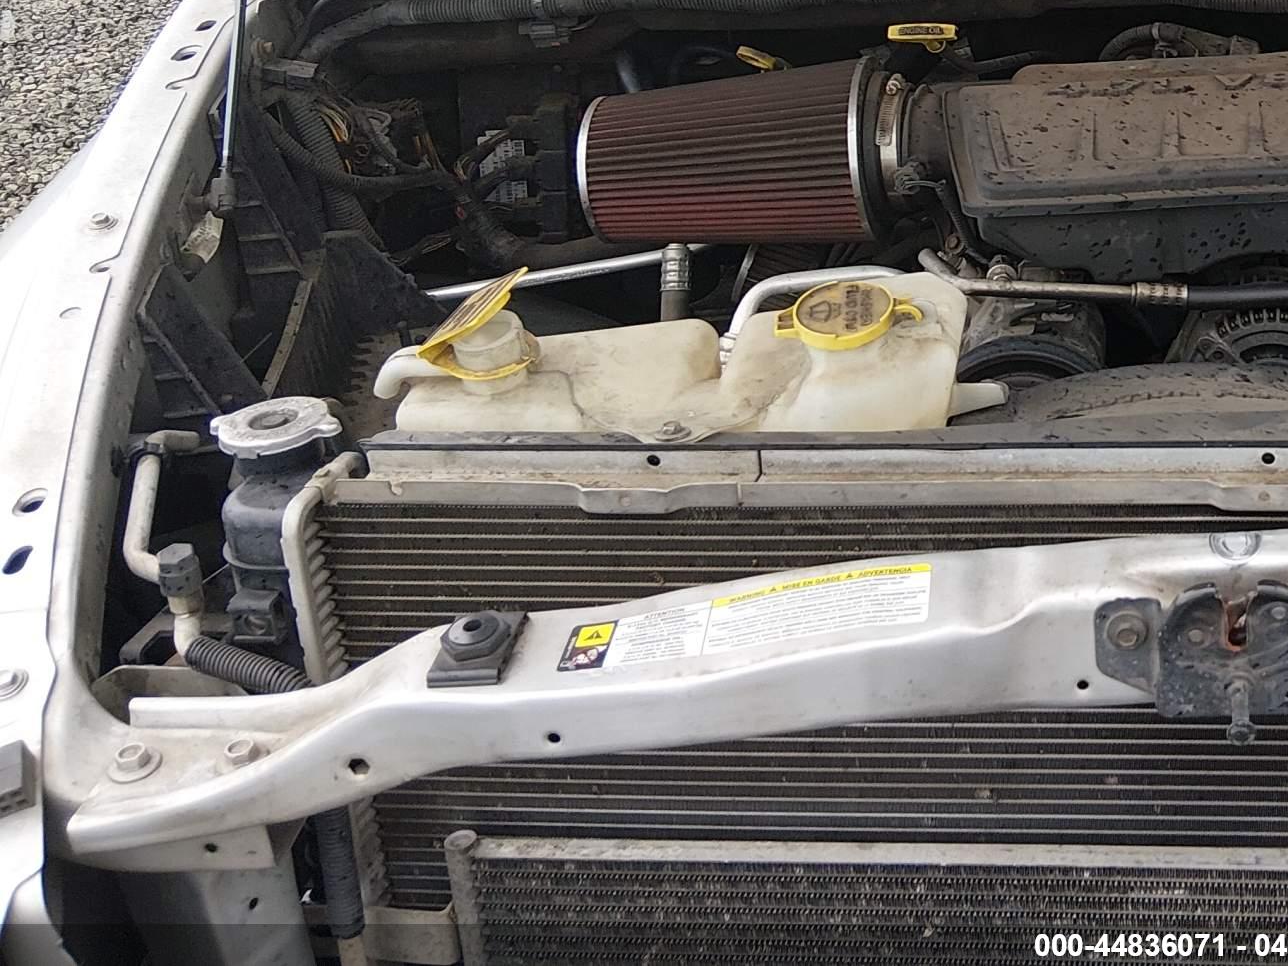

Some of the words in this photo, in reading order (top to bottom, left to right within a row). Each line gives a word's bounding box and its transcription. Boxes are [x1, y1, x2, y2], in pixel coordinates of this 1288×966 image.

[899, 26, 927, 35] ENGINE
[928, 26, 943, 35] OIL
[858, 567, 912, 578] ADVERTENCIA
